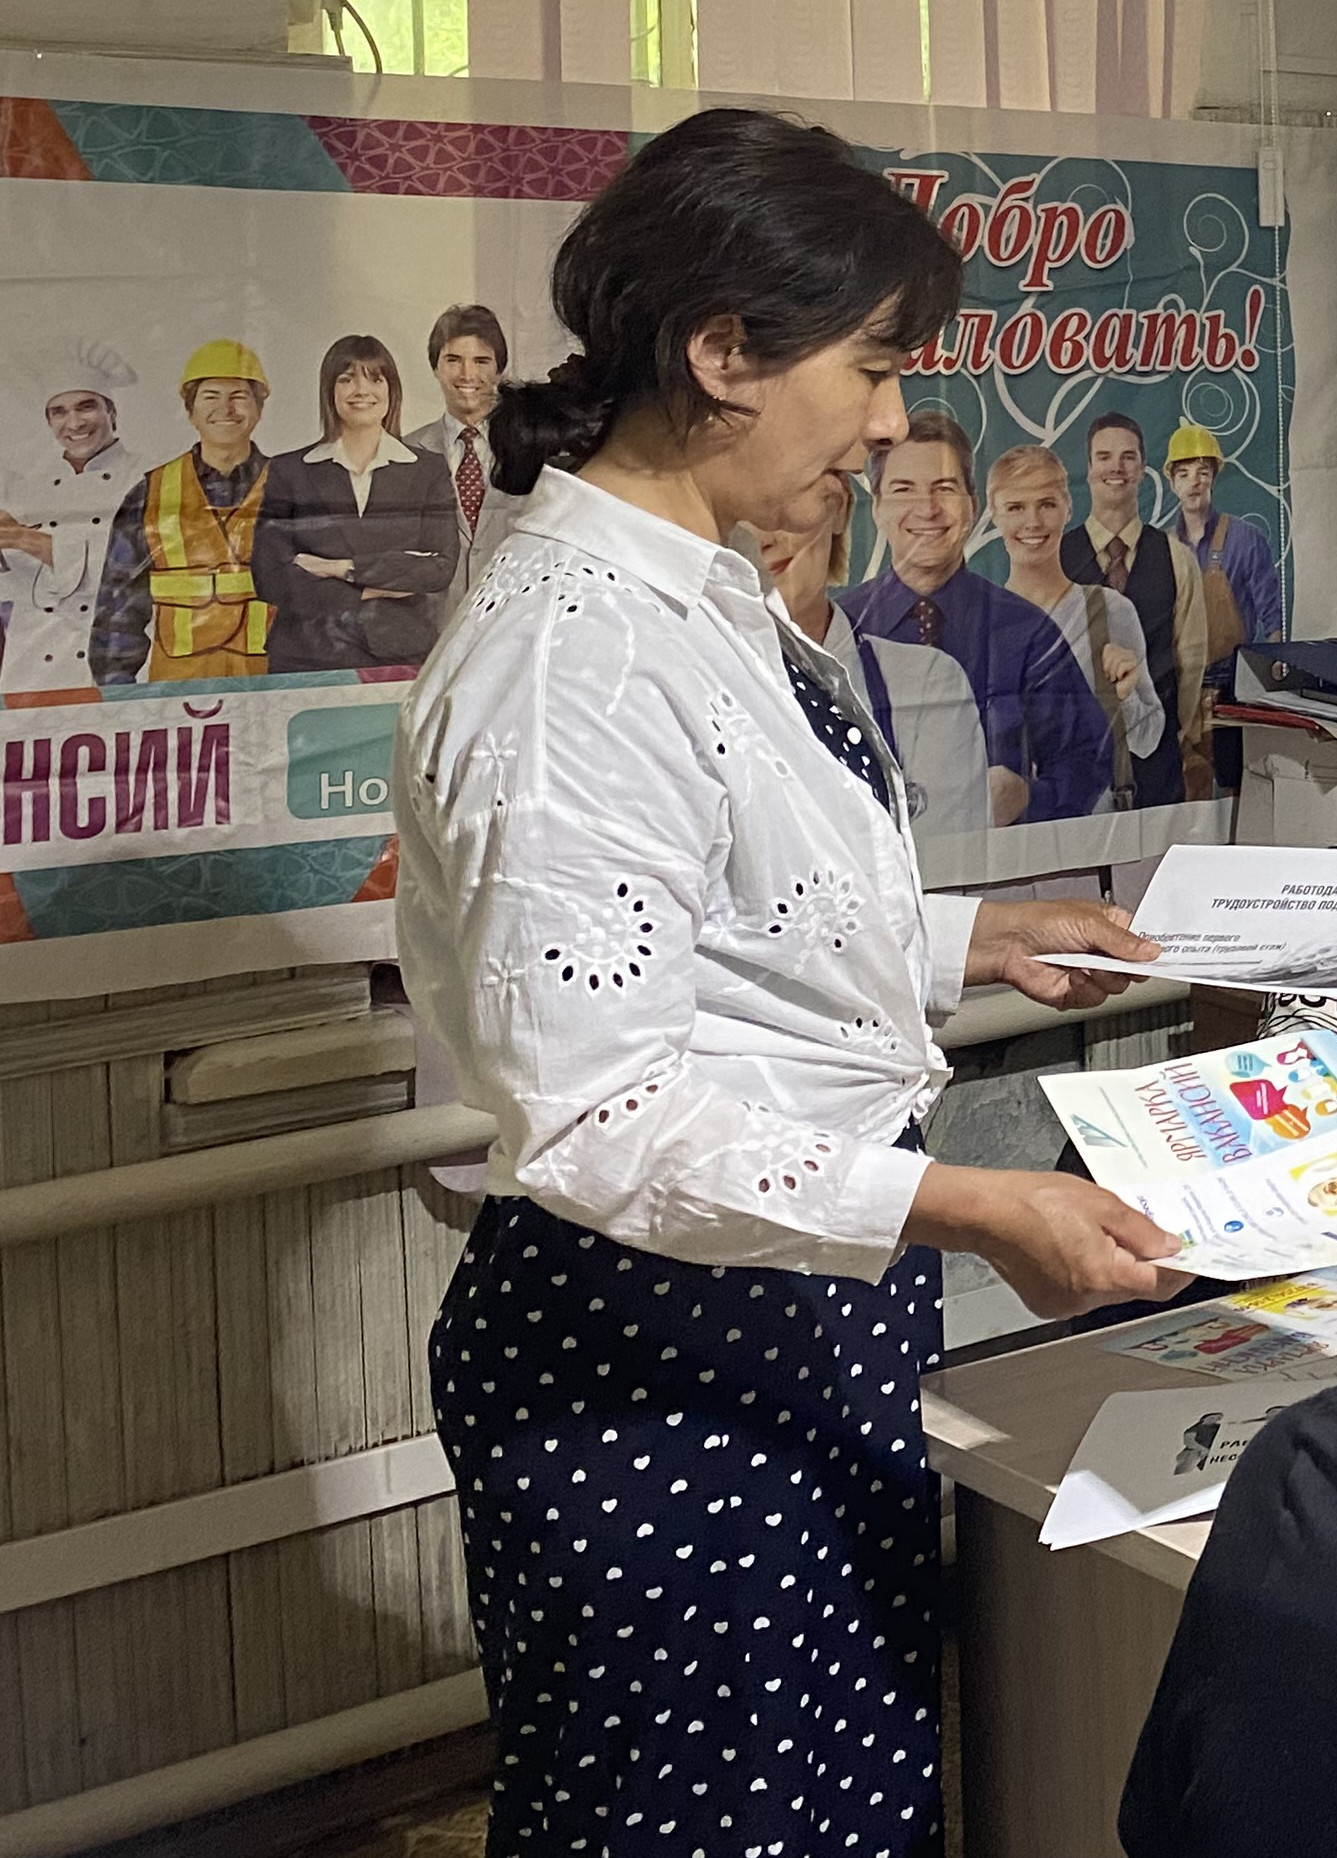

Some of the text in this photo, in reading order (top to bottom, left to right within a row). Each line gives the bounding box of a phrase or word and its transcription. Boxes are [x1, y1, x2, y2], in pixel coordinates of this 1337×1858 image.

[1211, 897, 1315, 911] ТРУДОУСТРОЙСТВО
[1135, 1079, 1207, 1161] ЯРМАРКА
[1159, 1062, 1253, 1164] ВАКАНСИЙ
